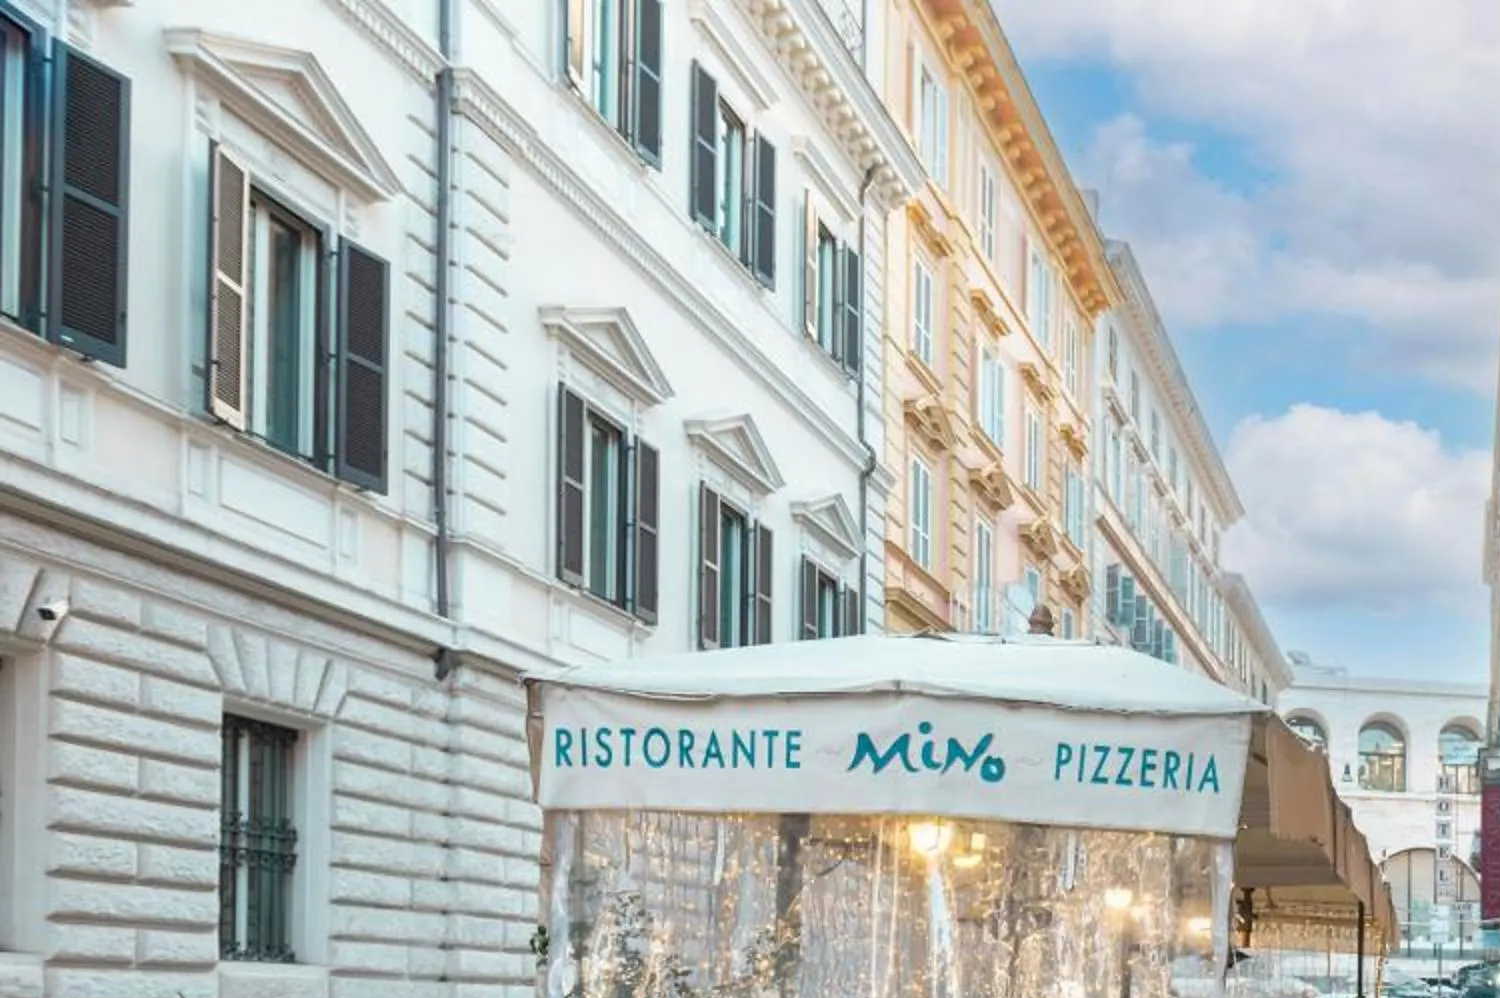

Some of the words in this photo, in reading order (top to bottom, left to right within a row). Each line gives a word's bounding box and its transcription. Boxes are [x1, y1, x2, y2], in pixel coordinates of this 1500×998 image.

[554, 726, 802, 770] RISTORANTE
[1055, 742, 1221, 794] PIZZERIA
[1438, 776, 1451, 882] HOTEL
